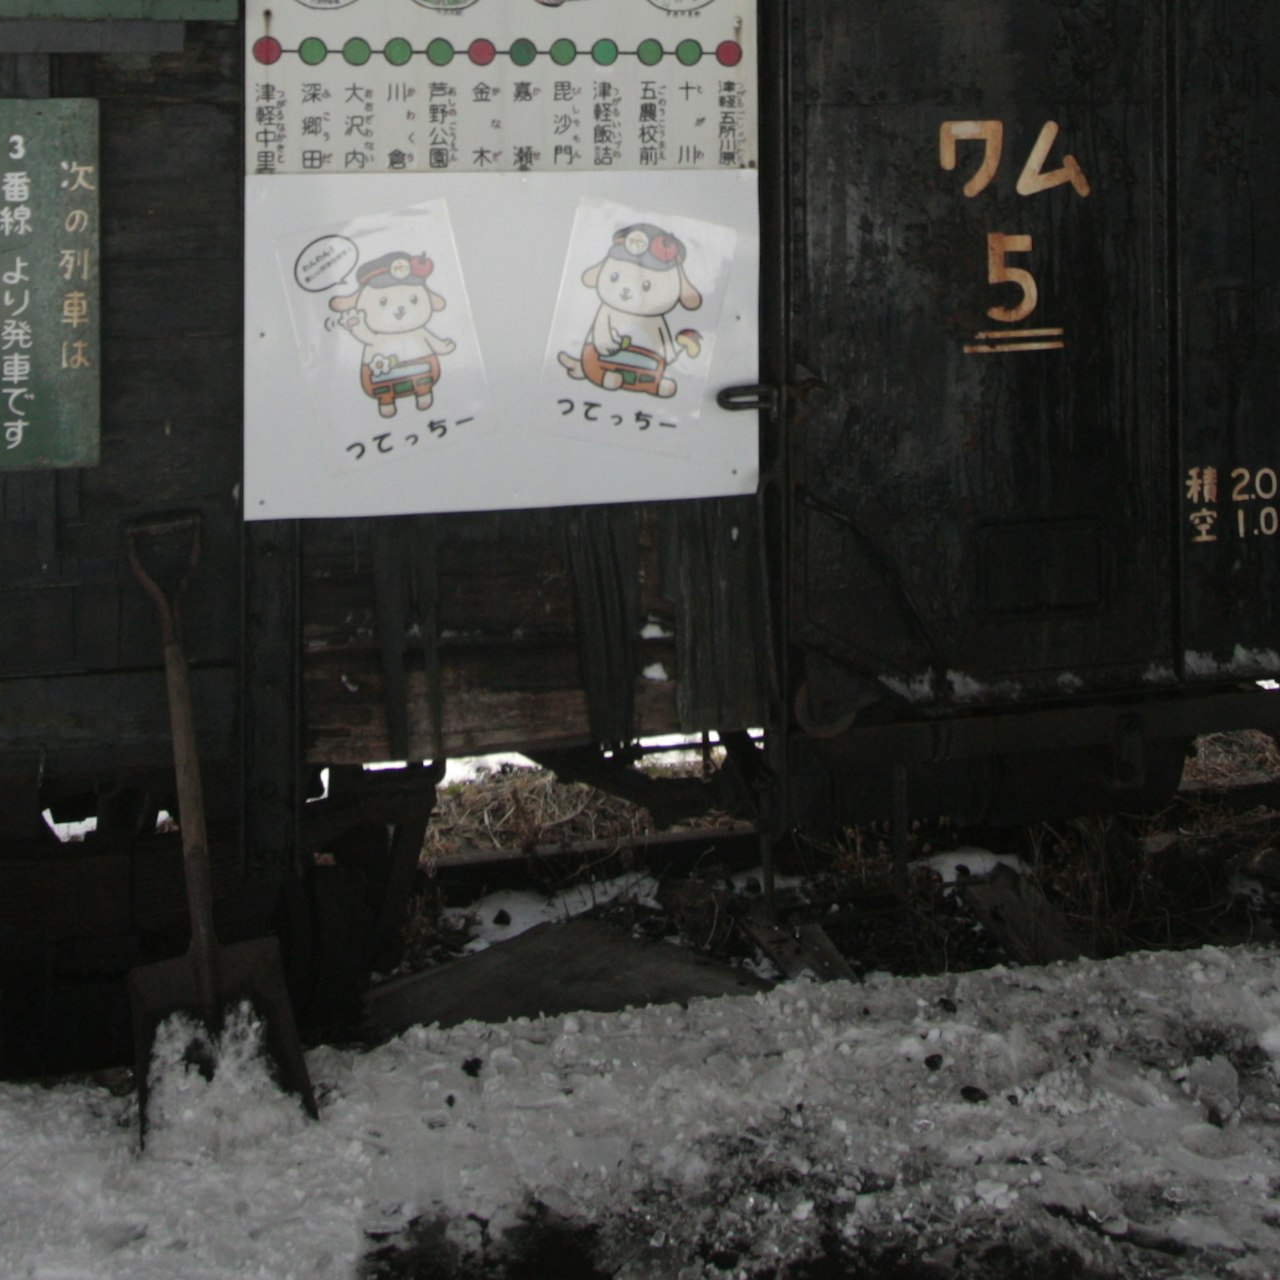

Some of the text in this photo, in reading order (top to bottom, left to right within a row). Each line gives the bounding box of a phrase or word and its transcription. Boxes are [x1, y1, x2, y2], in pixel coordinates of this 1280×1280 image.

[254, 83, 276, 169] 津軽中里
[301, 83, 322, 169] 深郷田
[322, 89, 333, 165] ふこうだ
[345, 83, 365, 169] 大沢内
[387, 84, 407, 169] 川倉
[428, 82, 448, 168] 芦野公園
[472, 81, 492, 167] 金木
[513, 81, 533, 166] 嘉瀬
[554, 81, 573, 166] 毘沙門
[593, 81, 613, 166] 津軽飯詰
[639, 81, 658, 165] 五農校前
[678, 81, 698, 164] 十川
[718, 80, 736, 165] 津軽五所川原
[937, 119, 1091, 199] ワム
[59, 160, 96, 370] 次の列車は
[984, 230, 1038, 323] 5
[1185, 465, 1279, 505] 積 2.0
[1189, 505, 1280, 544] 空 1.0
